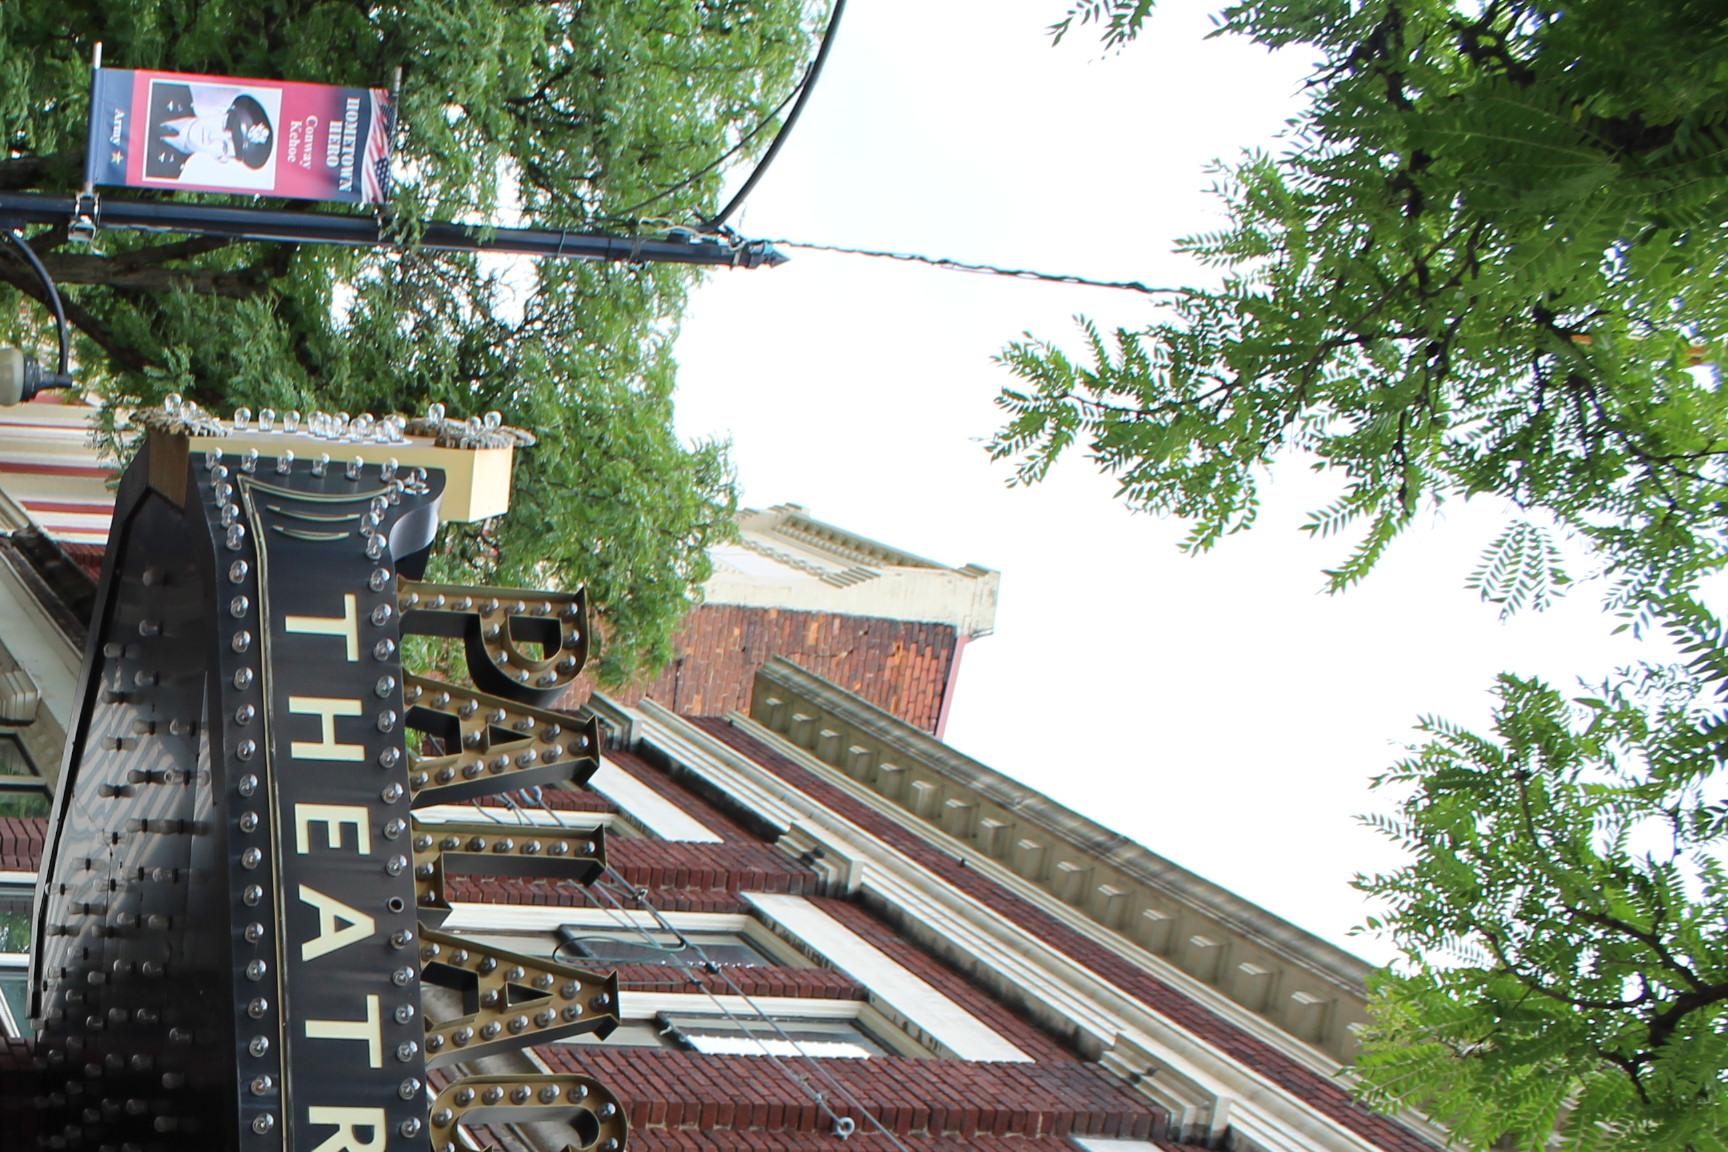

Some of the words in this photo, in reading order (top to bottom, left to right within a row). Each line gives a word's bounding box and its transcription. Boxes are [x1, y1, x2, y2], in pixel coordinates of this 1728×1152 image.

[110, 108, 127, 146] Army
[287, 121, 303, 163] Kehoe
[299, 115, 319, 170] Conway
[325, 120, 342, 168] HERO
[338, 98, 361, 194] HOMETOWN
